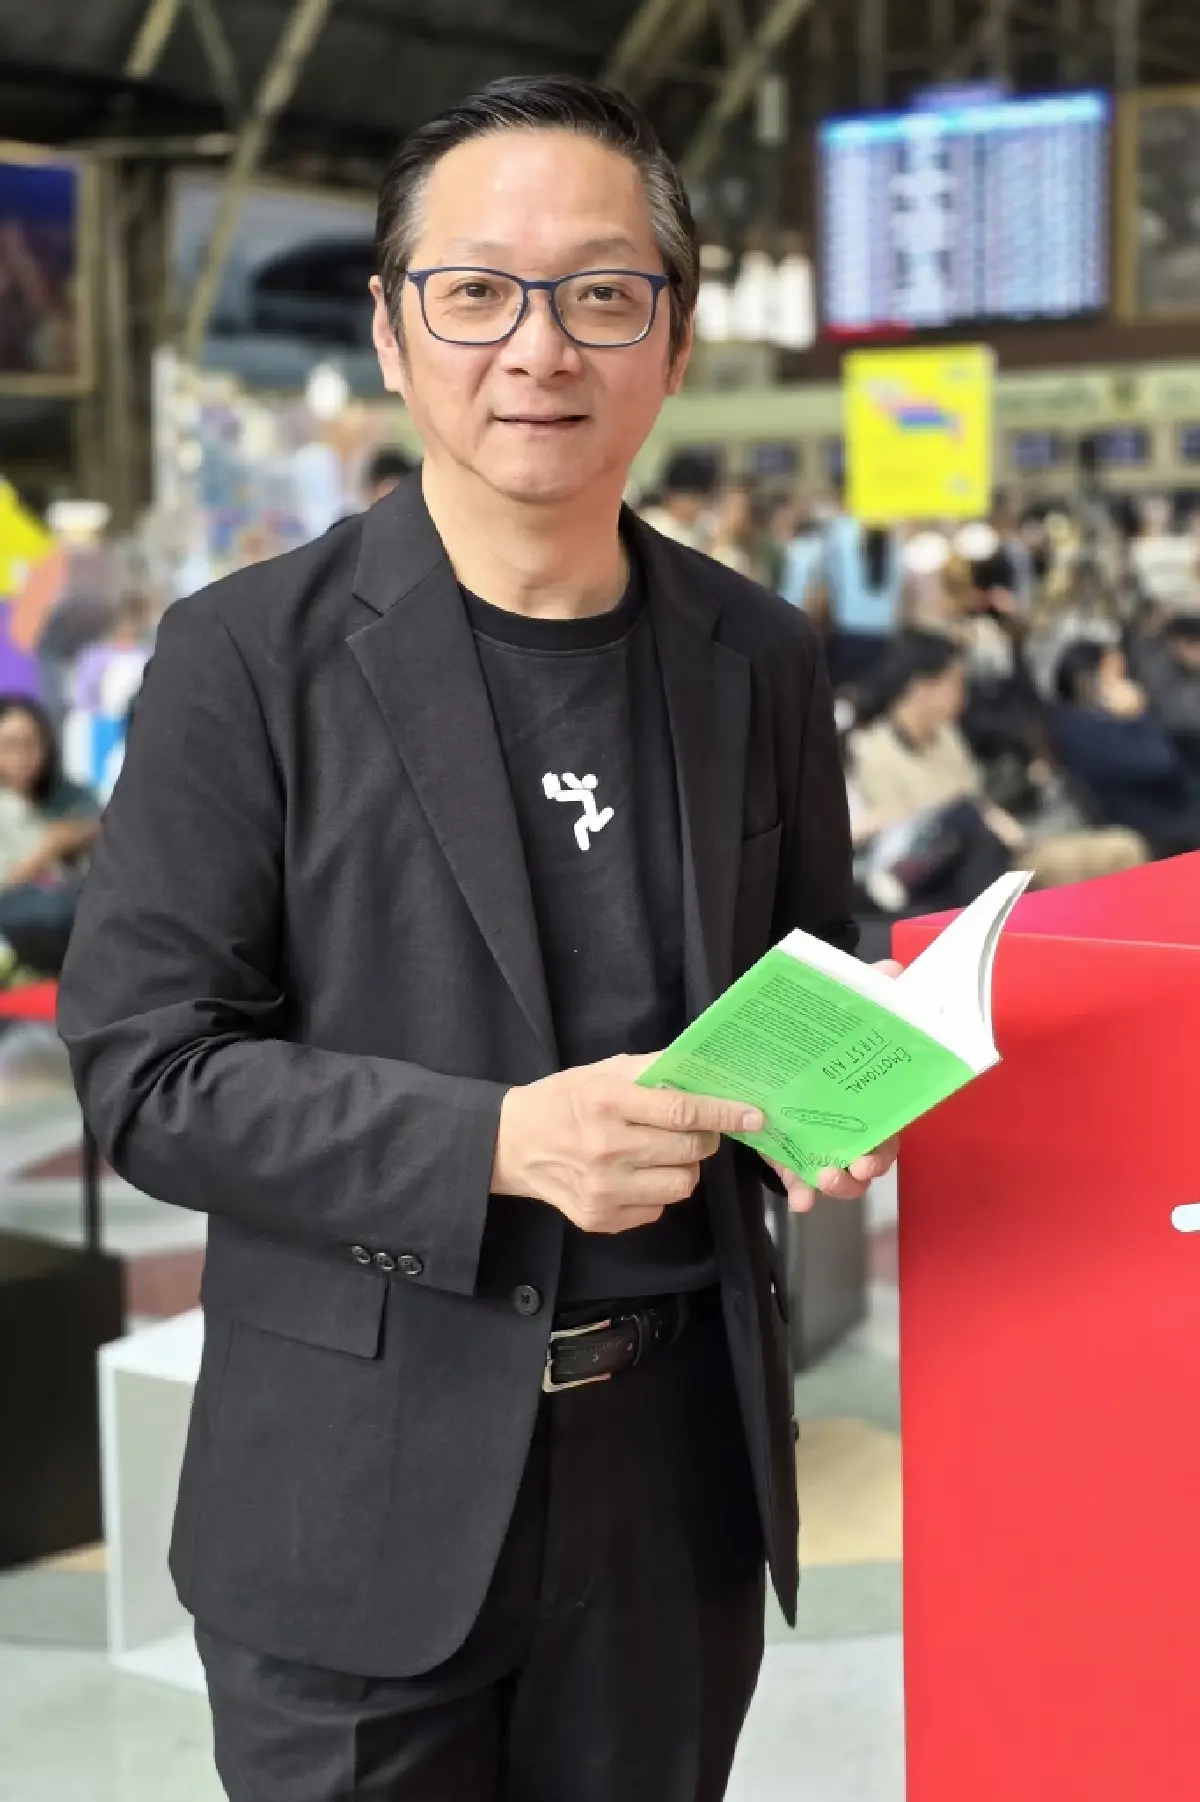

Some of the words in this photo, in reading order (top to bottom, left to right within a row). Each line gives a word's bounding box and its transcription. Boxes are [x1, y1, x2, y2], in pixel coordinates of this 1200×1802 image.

[844, 1028, 885, 1064] FIRST
[822, 1058, 847, 1080] AID
[845, 1046, 912, 1094] EMOTIONAL
